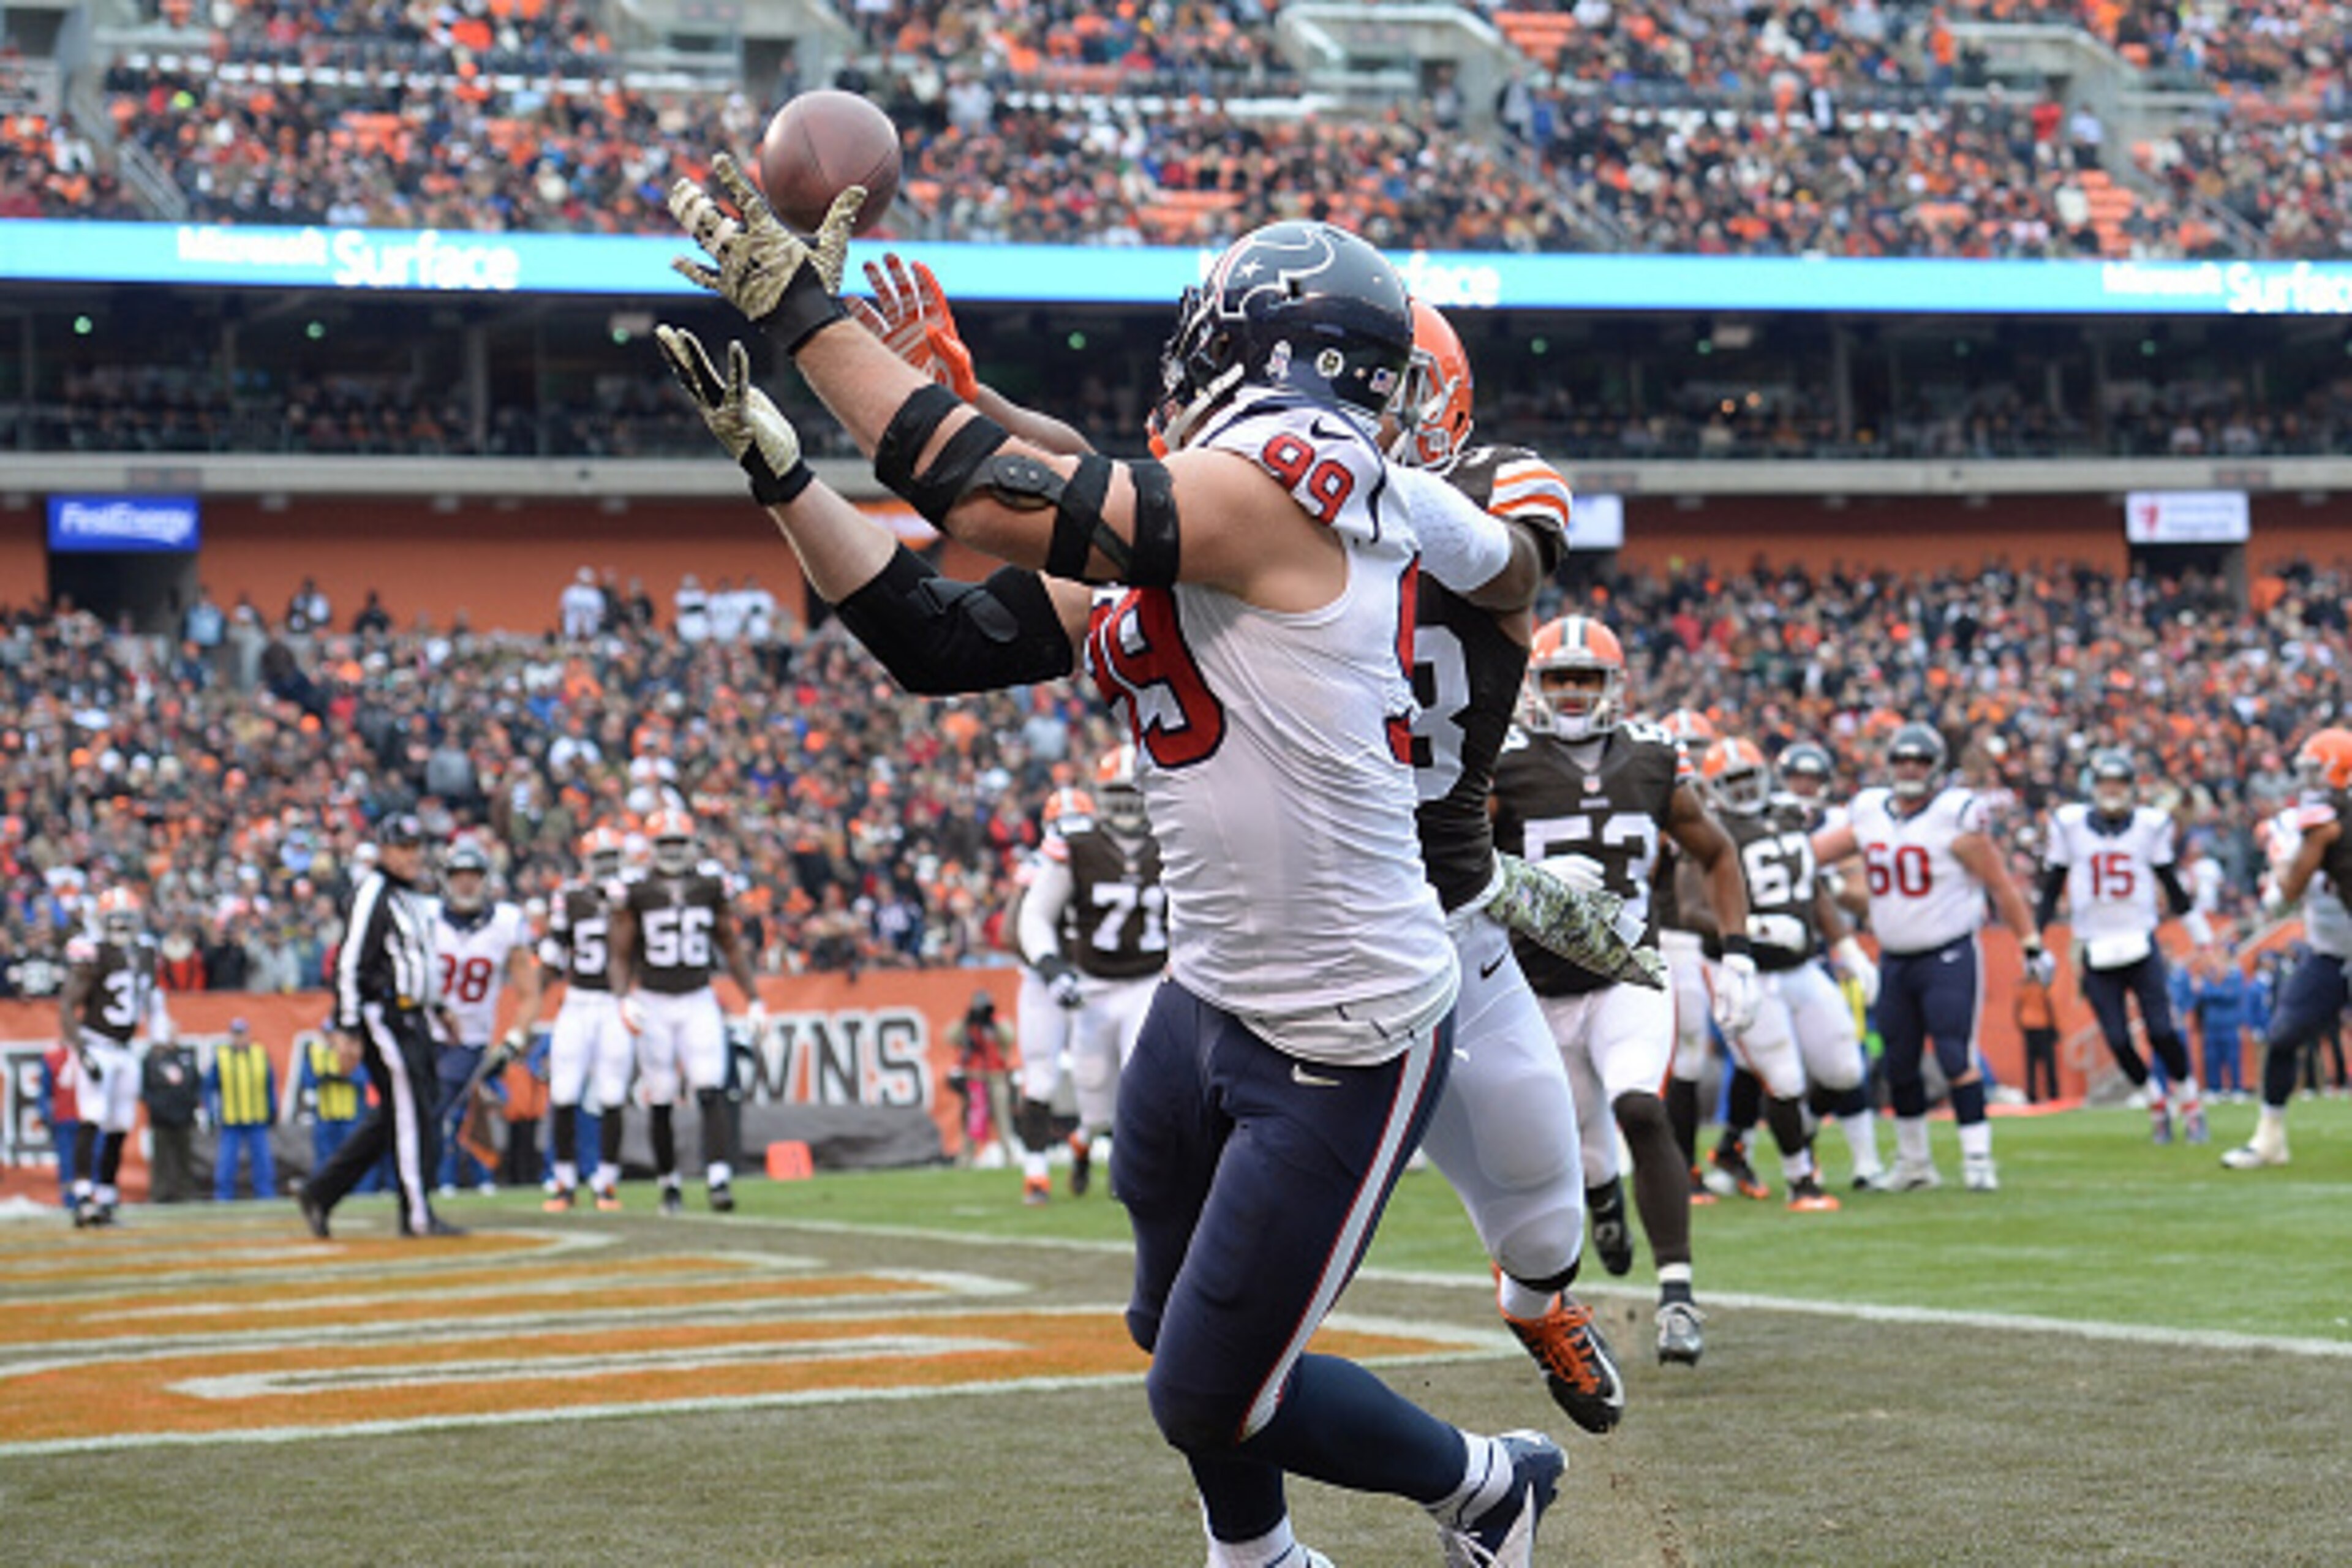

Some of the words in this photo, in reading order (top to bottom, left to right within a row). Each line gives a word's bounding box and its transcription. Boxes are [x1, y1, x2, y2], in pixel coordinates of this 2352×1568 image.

[333, 229, 519, 290] Surface
[2226, 260, 2352, 313] Surfac
[1264, 432, 1355, 527] 99
[61, 502, 195, 544] FirstEnergy
[1525, 812, 1658, 921] 53
[1743, 831, 1815, 907] 67
[1866, 842, 1932, 898] 60
[2090, 852, 2135, 899] 15
[643, 907, 714, 967] 56
[1092, 882, 1167, 951] 71
